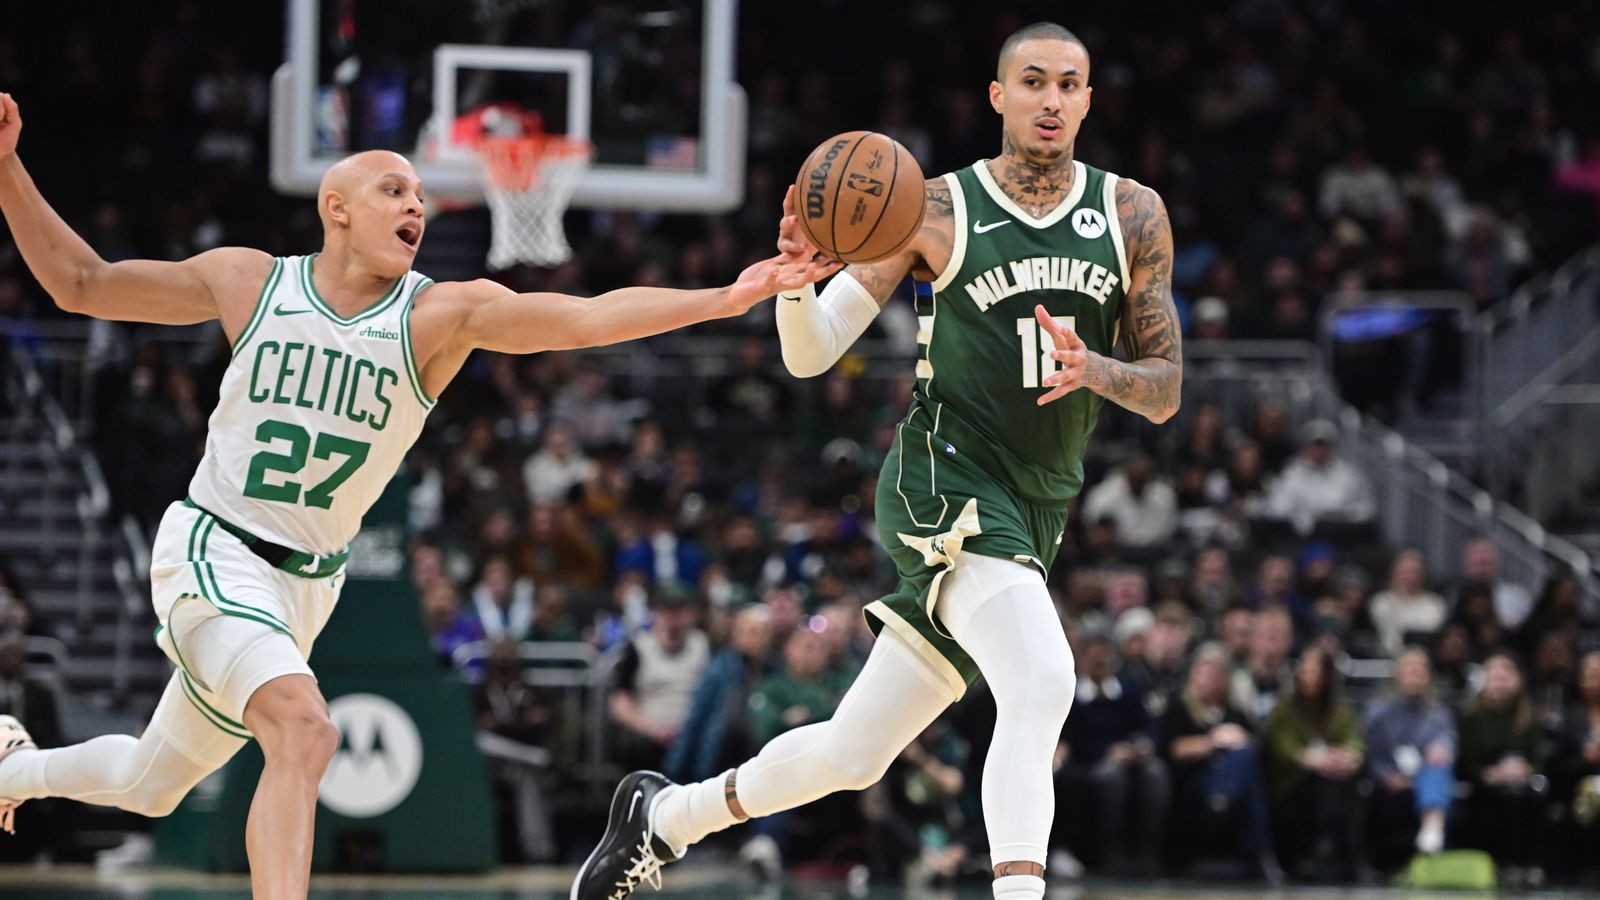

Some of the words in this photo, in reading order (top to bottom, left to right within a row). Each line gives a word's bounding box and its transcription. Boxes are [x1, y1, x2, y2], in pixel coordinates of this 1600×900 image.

[964, 257, 1120, 313] MILWAUKEE
[359, 326, 399, 340] Amica
[248, 340, 398, 431] CELTICS
[243, 419, 371, 510] 27
